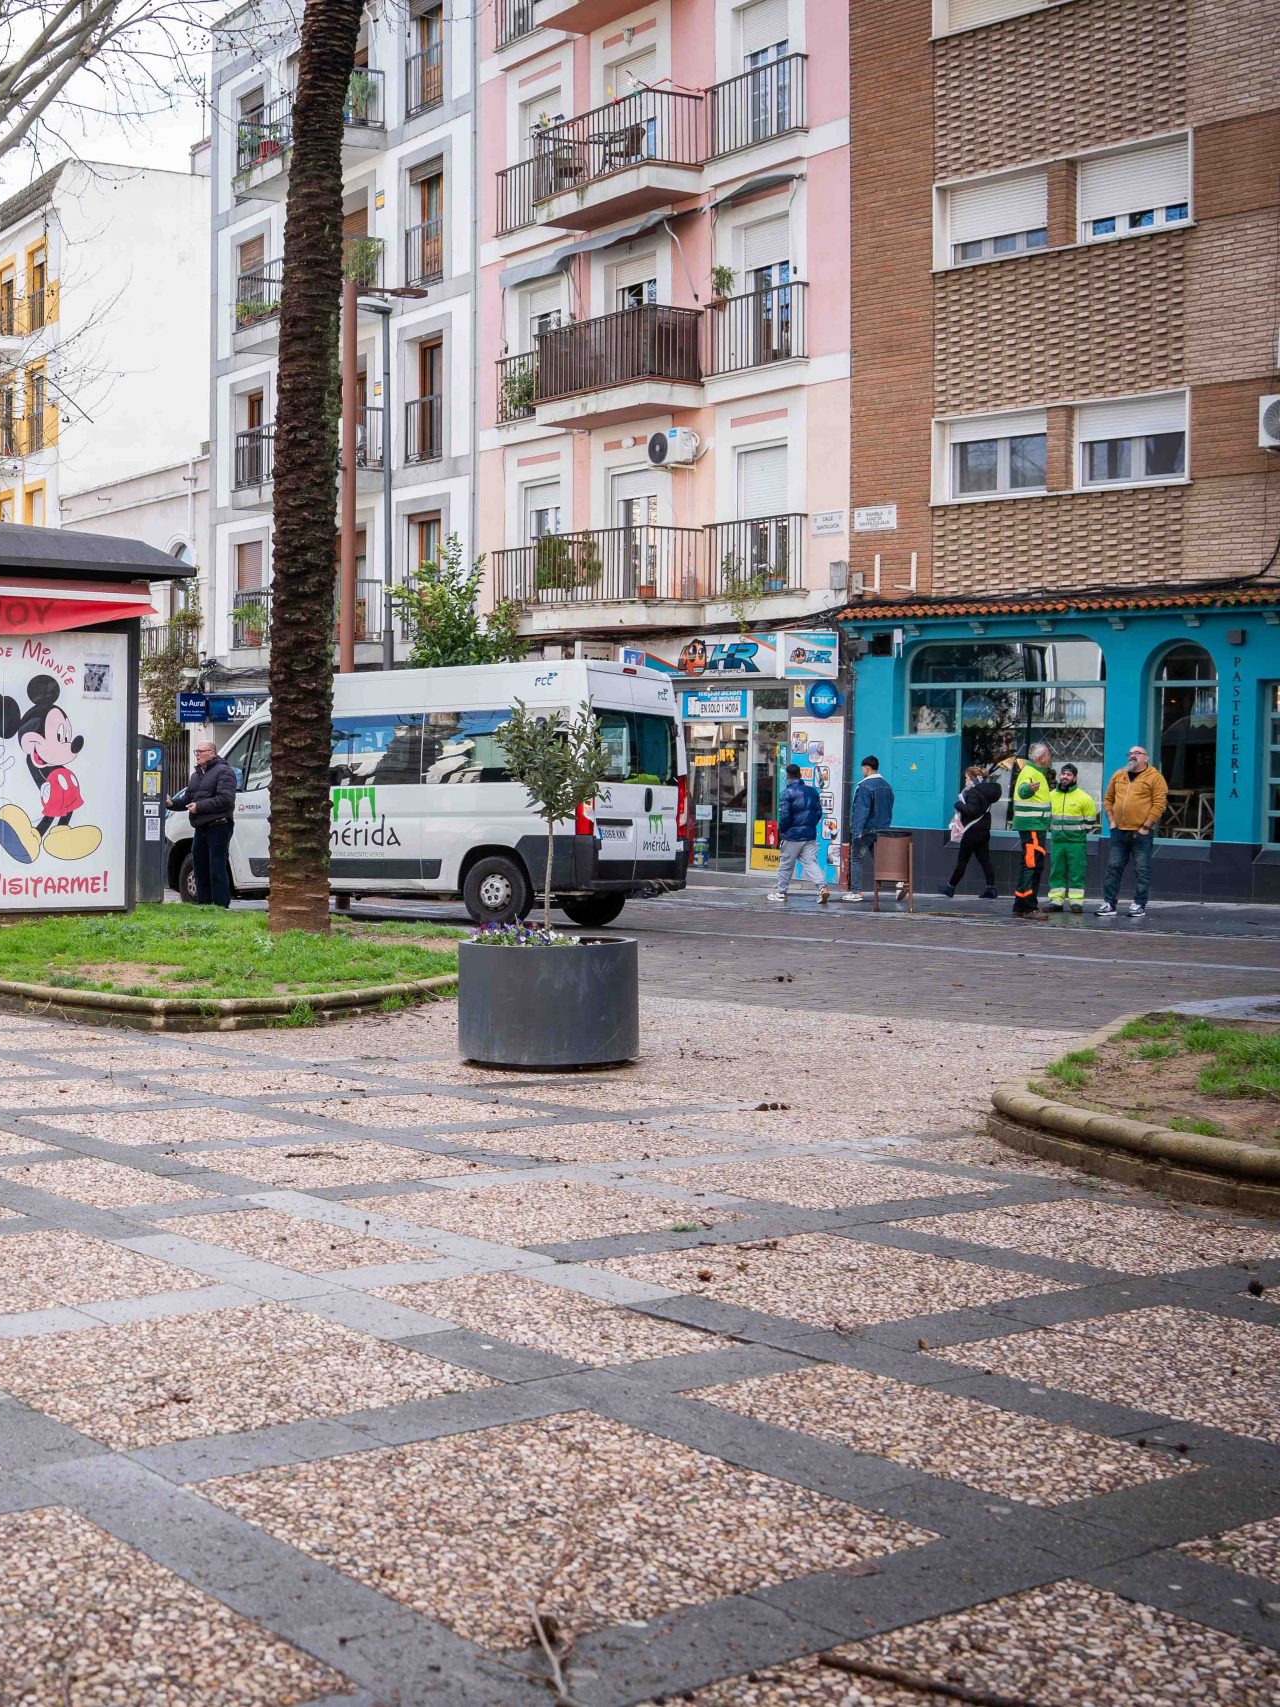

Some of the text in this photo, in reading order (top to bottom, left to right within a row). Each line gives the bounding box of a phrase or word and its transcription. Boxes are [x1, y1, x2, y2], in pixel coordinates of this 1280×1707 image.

[22, 639, 76, 685] MINNIE
[707, 643, 761, 672] HR
[807, 650, 832, 663] HR
[534, 676, 553, 686] FCC
[188, 699, 206, 707] Aural
[657, 691, 668, 701] FCC
[811, 696, 837, 704] DIGI
[235, 700, 257, 716] Aural
[701, 704, 707, 713] EN
[708, 703, 720, 713] SOLO
[724, 703, 739, 713] HORA
[1229, 656, 1242, 798] PASTELERÍA
[147, 750, 157, 767] P
[643, 833, 671, 852] mérida
